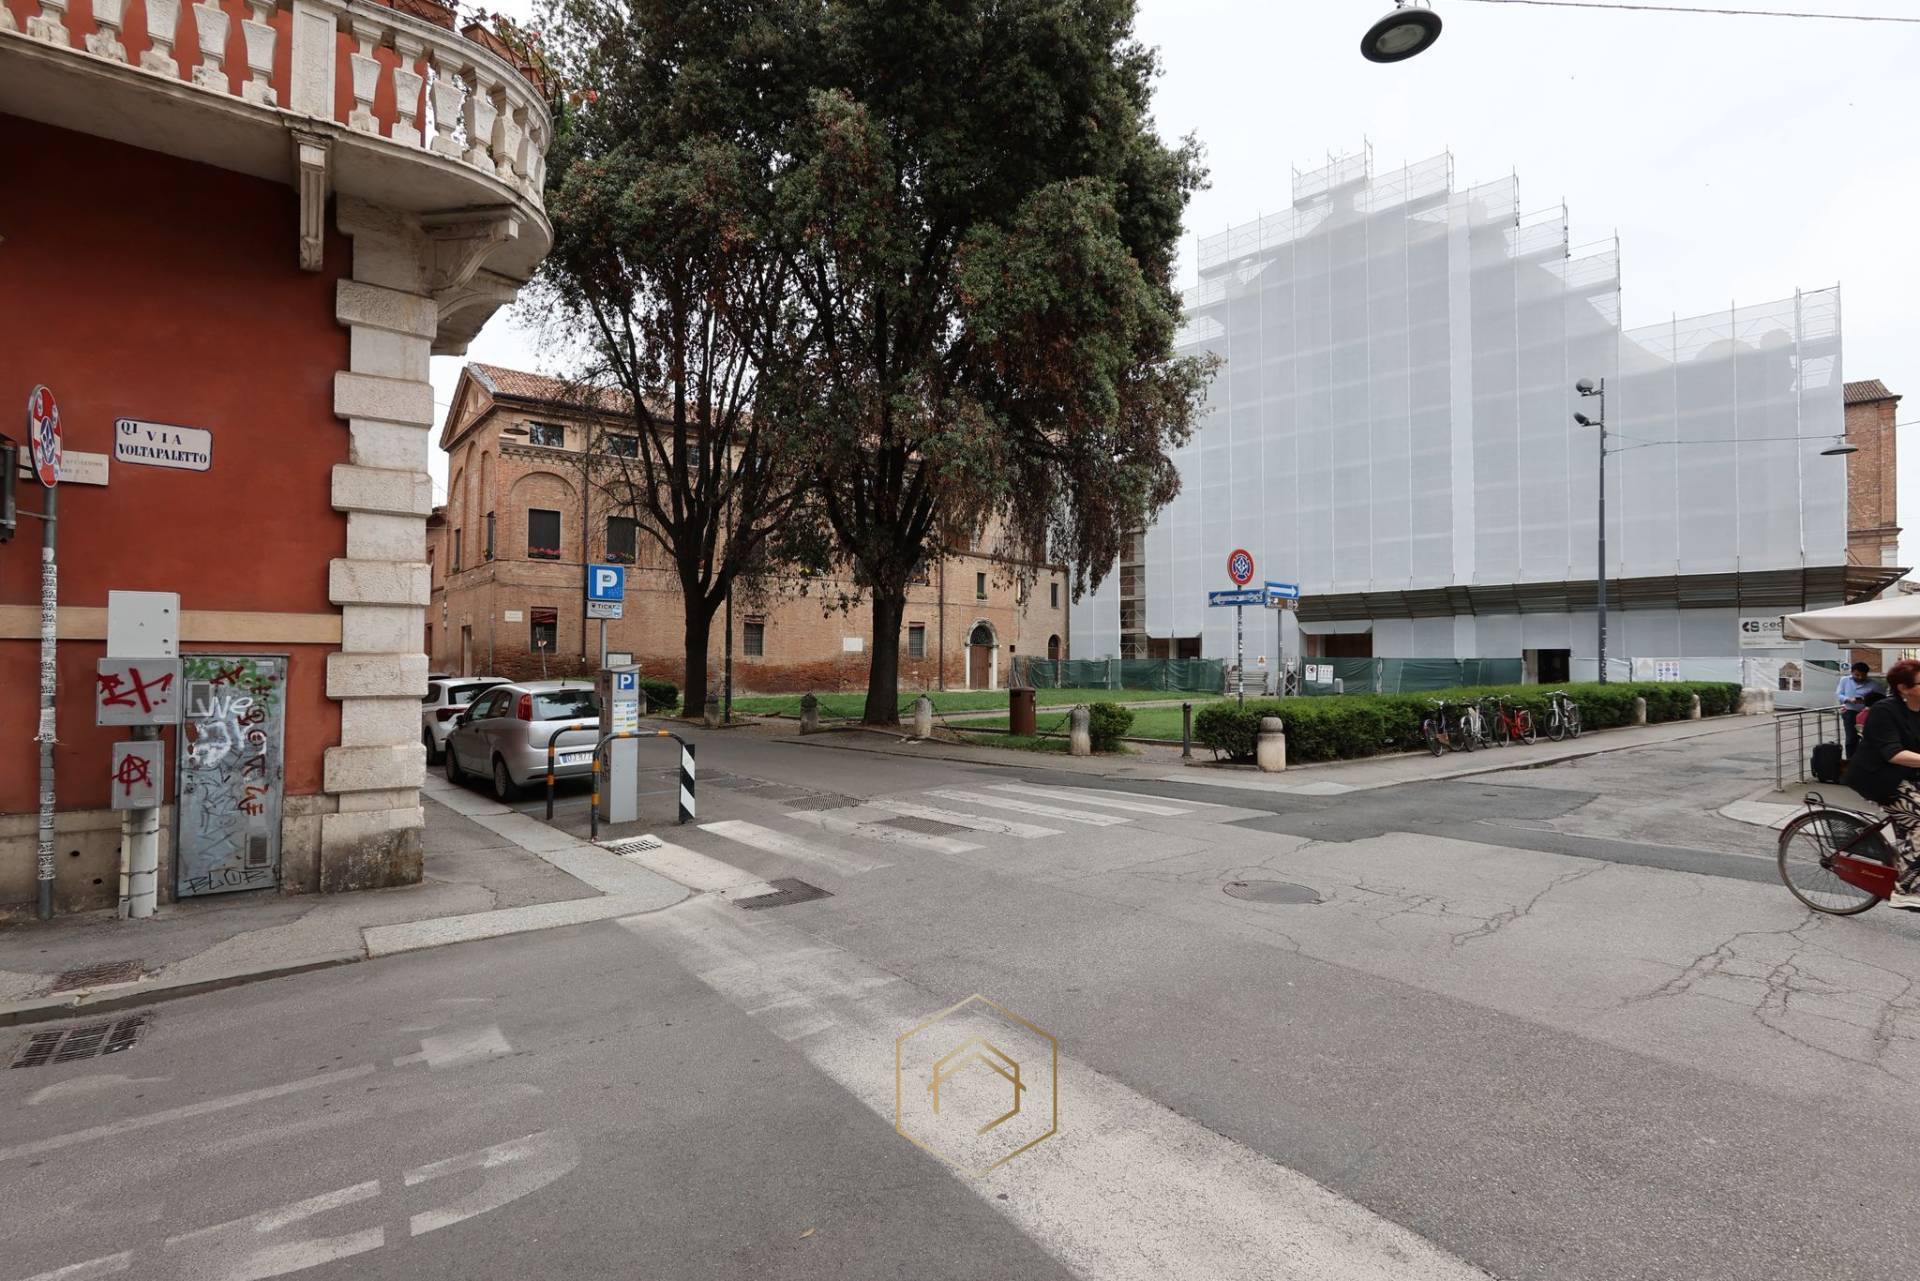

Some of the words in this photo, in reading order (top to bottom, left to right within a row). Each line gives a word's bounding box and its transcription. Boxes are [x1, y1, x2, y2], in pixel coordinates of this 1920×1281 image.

[121, 421, 138, 436] QI
[146, 430, 182, 446] VIA
[118, 443, 208, 464] VOLTAPALETTO
[596, 569, 618, 597] P
[620, 674, 632, 689] P
